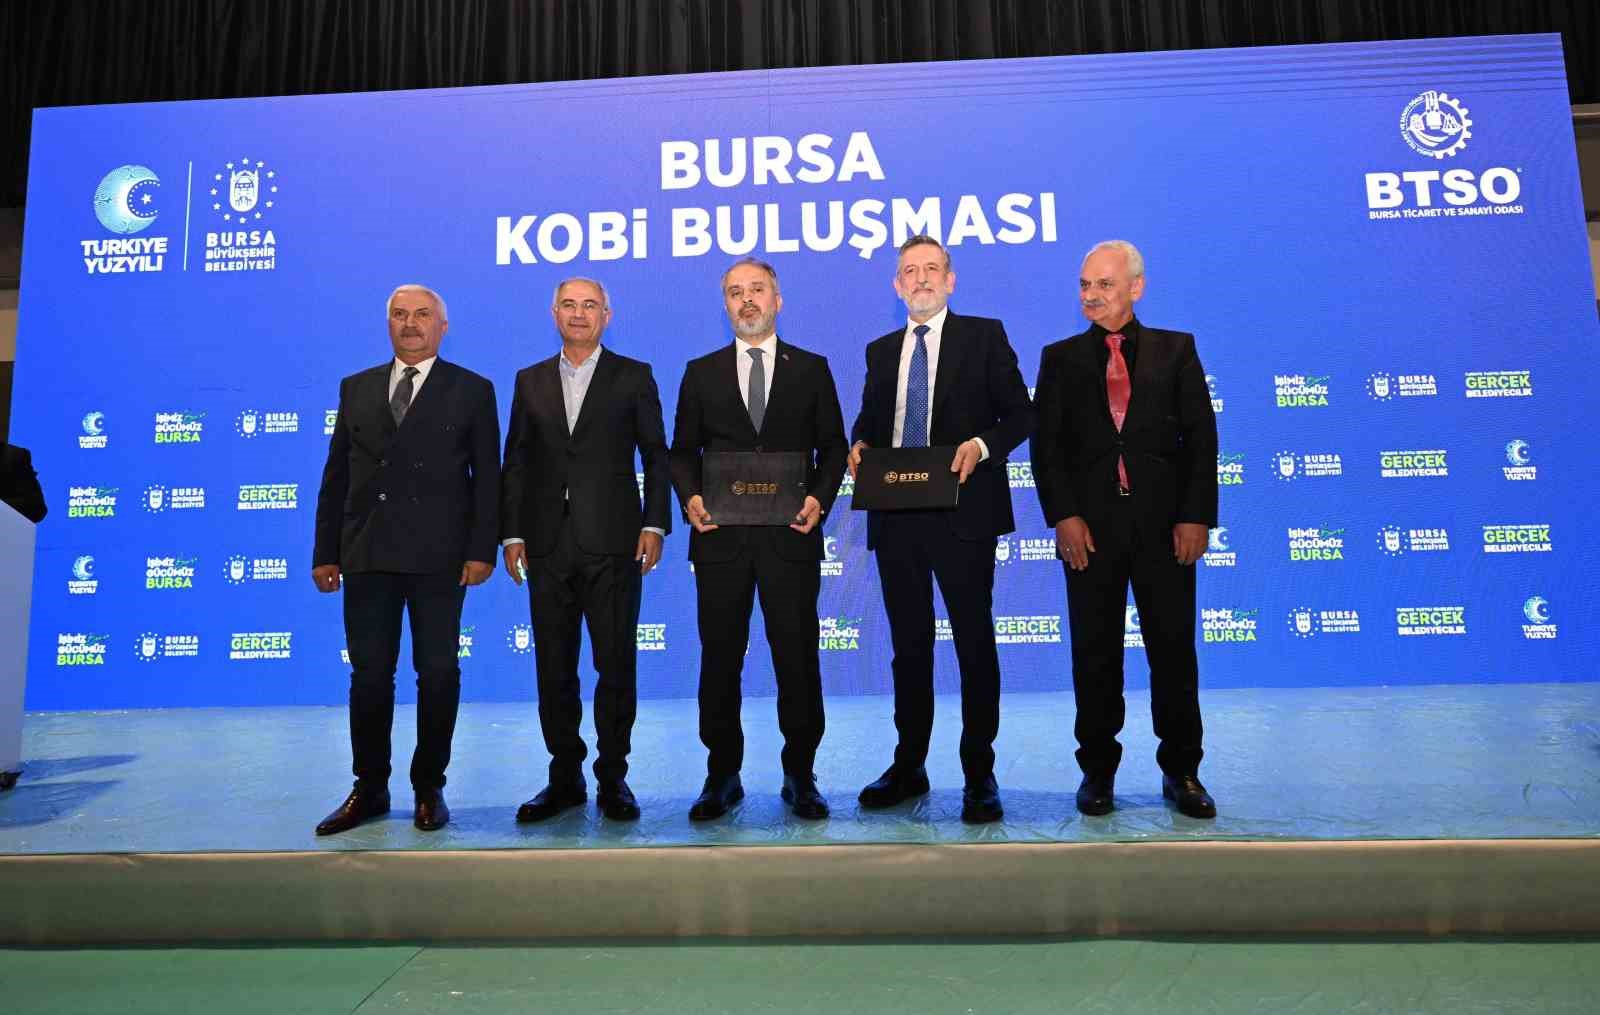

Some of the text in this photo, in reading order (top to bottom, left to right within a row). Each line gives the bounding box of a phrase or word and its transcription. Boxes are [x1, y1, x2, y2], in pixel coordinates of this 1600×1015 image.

[660, 131, 885, 190] BURSA
[1365, 167, 1520, 209] BTSO
[1369, 210, 1401, 220] BURSA
[1445, 208, 1456, 217] VE
[671, 192, 1058, 260] BULUŞMASI
[206, 230, 275, 247] BURSA
[1398, 375, 1436, 384] BURSA
[1277, 395, 1329, 407] BURSA
[265, 413, 298, 421] BURSA
[155, 432, 200, 443] BURSA
[1304, 454, 1341, 464] BURSA
[901, 472, 928, 480] BTSO
[172, 487, 204, 496] BURSA
[68, 506, 114, 518] BURSA
[1409, 529, 1448, 538] BURSA
[1020, 539, 1056, 548] BURSA
[1290, 548, 1344, 561] BURSA
[253, 559, 287, 568] BURSA
[146, 577, 192, 589] BURSA
[1320, 610, 1359, 620] BURSA
[165, 636, 199, 644] BURSA
[1204, 629, 1256, 642] BURSA
[818, 638, 859, 650] URSA
[56, 653, 104, 666] BURSA
